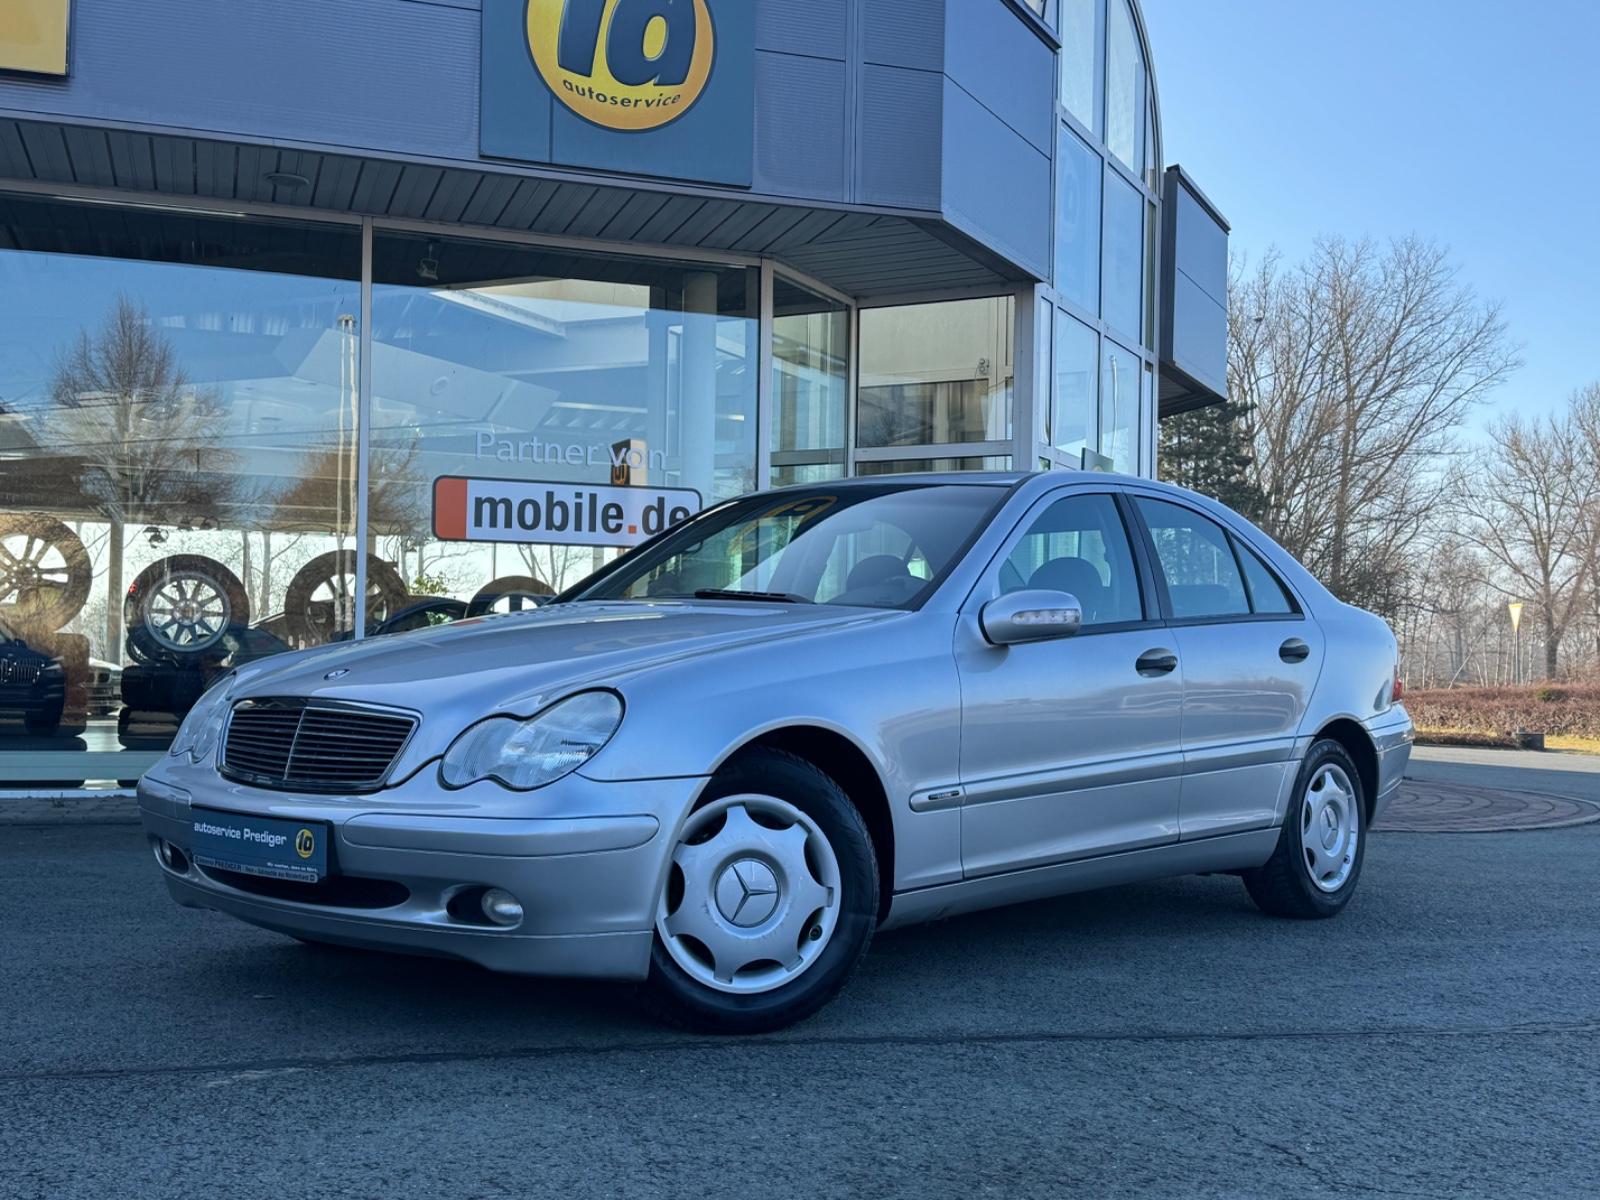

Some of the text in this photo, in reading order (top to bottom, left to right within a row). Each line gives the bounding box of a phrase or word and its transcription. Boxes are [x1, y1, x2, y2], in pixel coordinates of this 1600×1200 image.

[562, 79, 681, 109] autoservice
[475, 431, 667, 471] Partner von
[473, 491, 690, 536] mobile.de
[194, 822, 287, 847] autoservice Prediger
